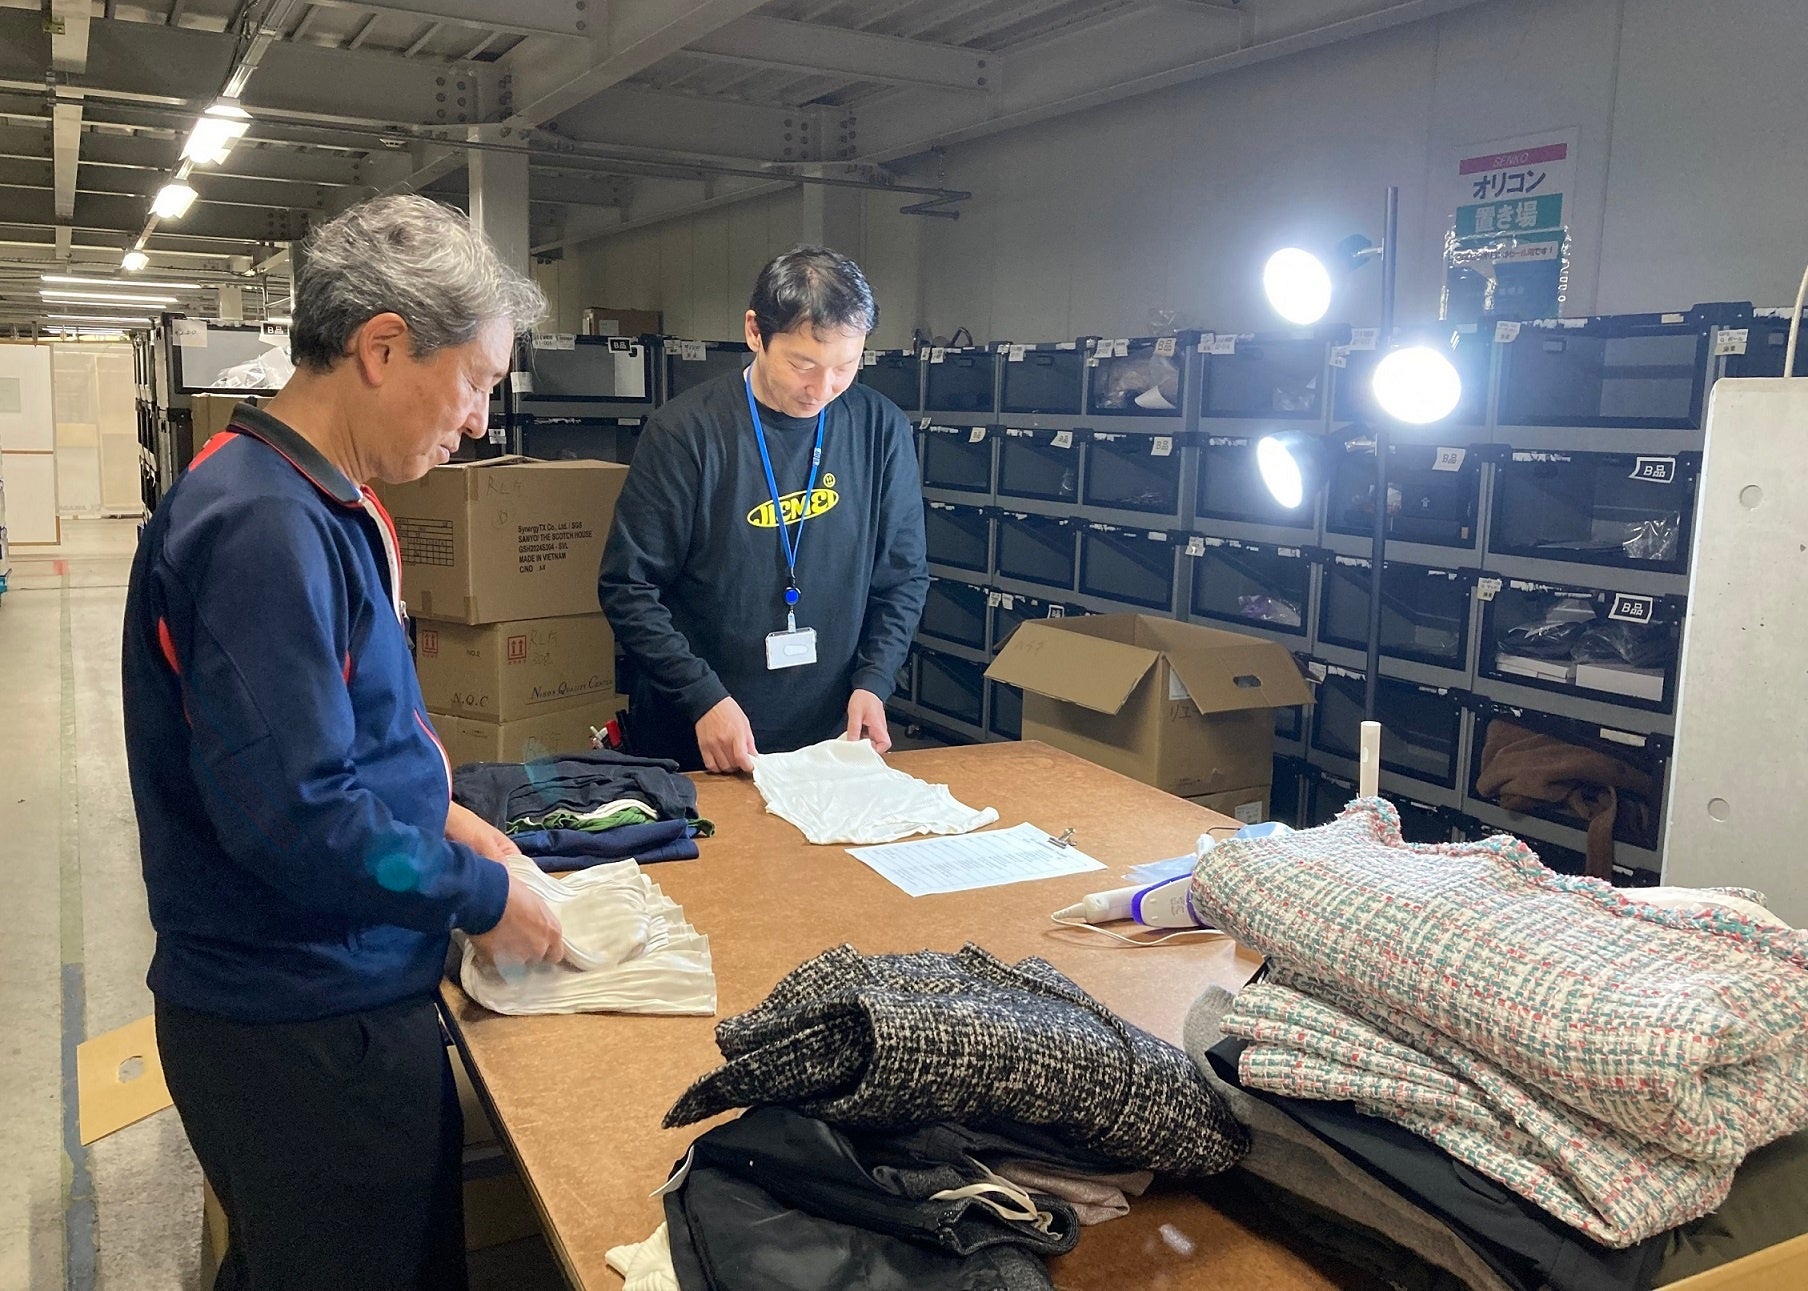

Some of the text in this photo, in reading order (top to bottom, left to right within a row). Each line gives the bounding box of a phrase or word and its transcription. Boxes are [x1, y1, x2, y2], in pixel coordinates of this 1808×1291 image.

[1473, 170, 1546, 199] オリコン
[1475, 200, 1538, 232] 置き場
[1643, 464, 1666, 478] B品
[518, 524, 546, 534] SynergyTX
[540, 533, 551, 541] THE
[552, 531, 573, 540] SCOTCH
[574, 530, 592, 539] HOUSE
[519, 554, 535, 563] MADE
[1621, 603, 1644, 616] B品
